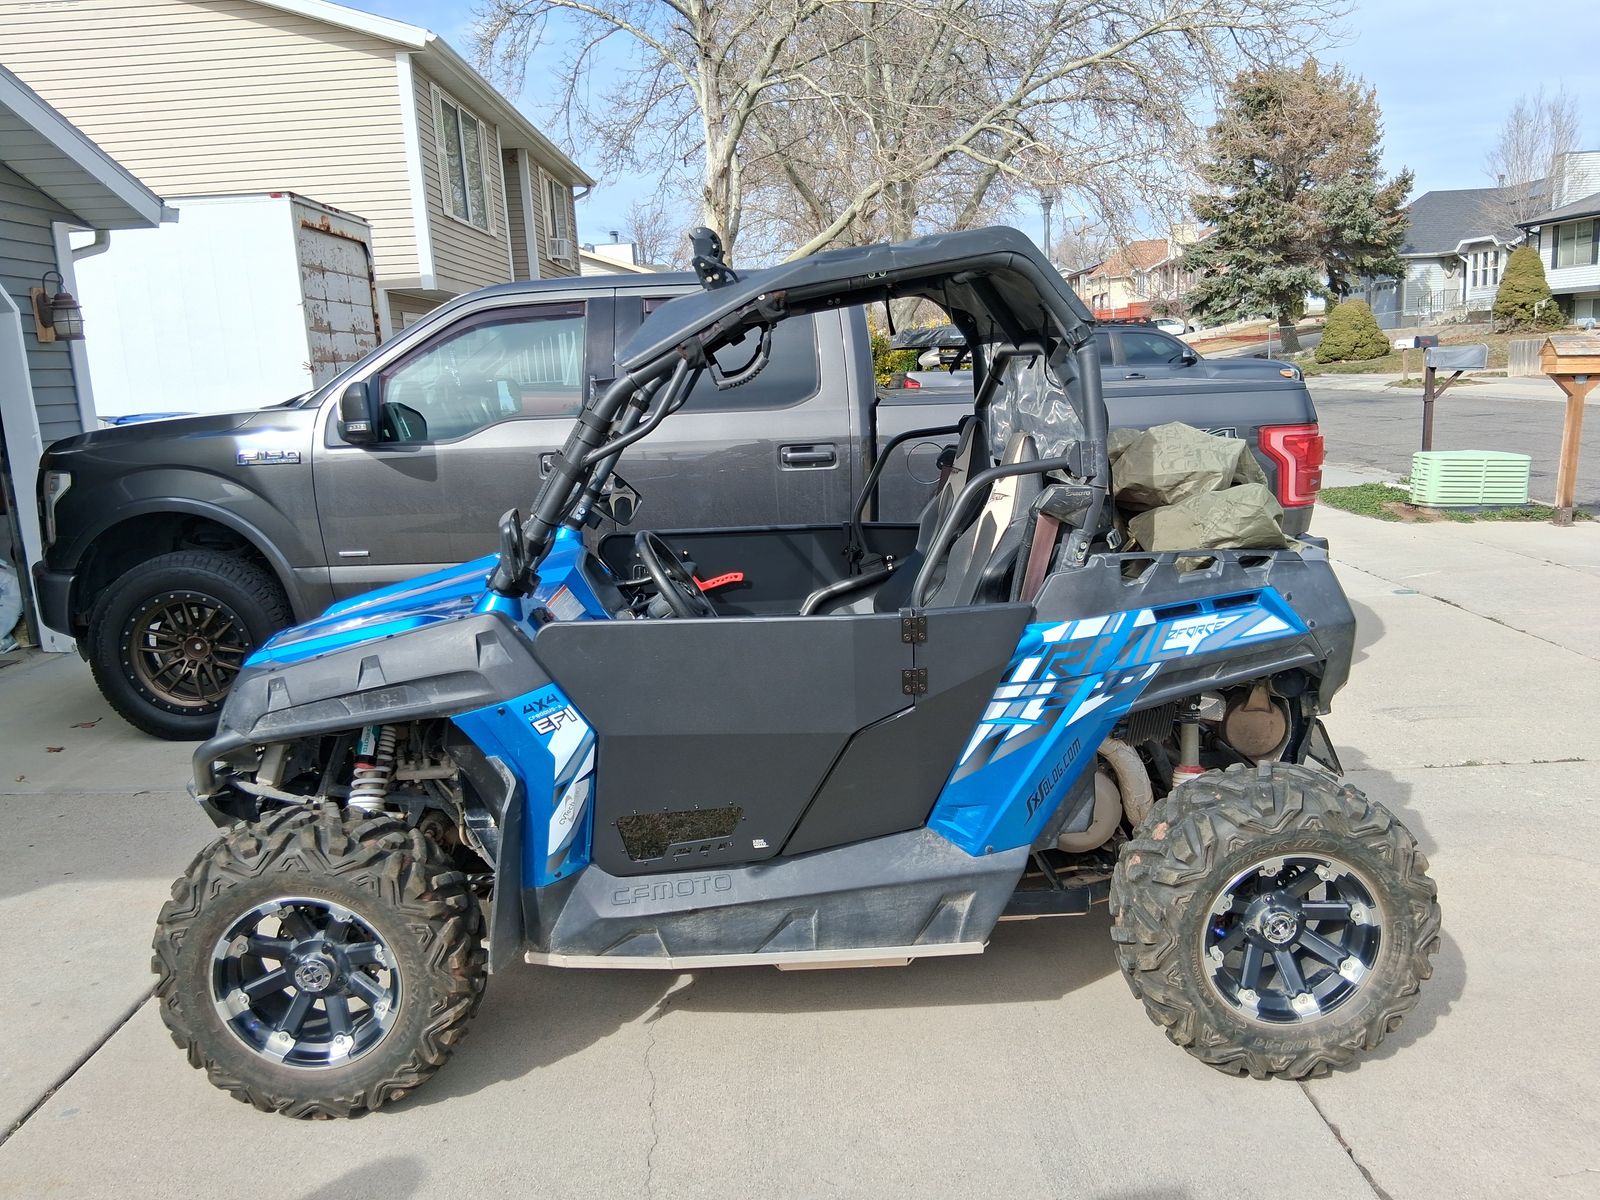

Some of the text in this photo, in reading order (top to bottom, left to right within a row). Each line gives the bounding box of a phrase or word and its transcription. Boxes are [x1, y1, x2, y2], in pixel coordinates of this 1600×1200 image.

[1168, 620, 1226, 640] ZFORCE
[523, 694, 561, 714] 4X4
[530, 704, 578, 736] EFI
[611, 873, 732, 906] CFMOTO
